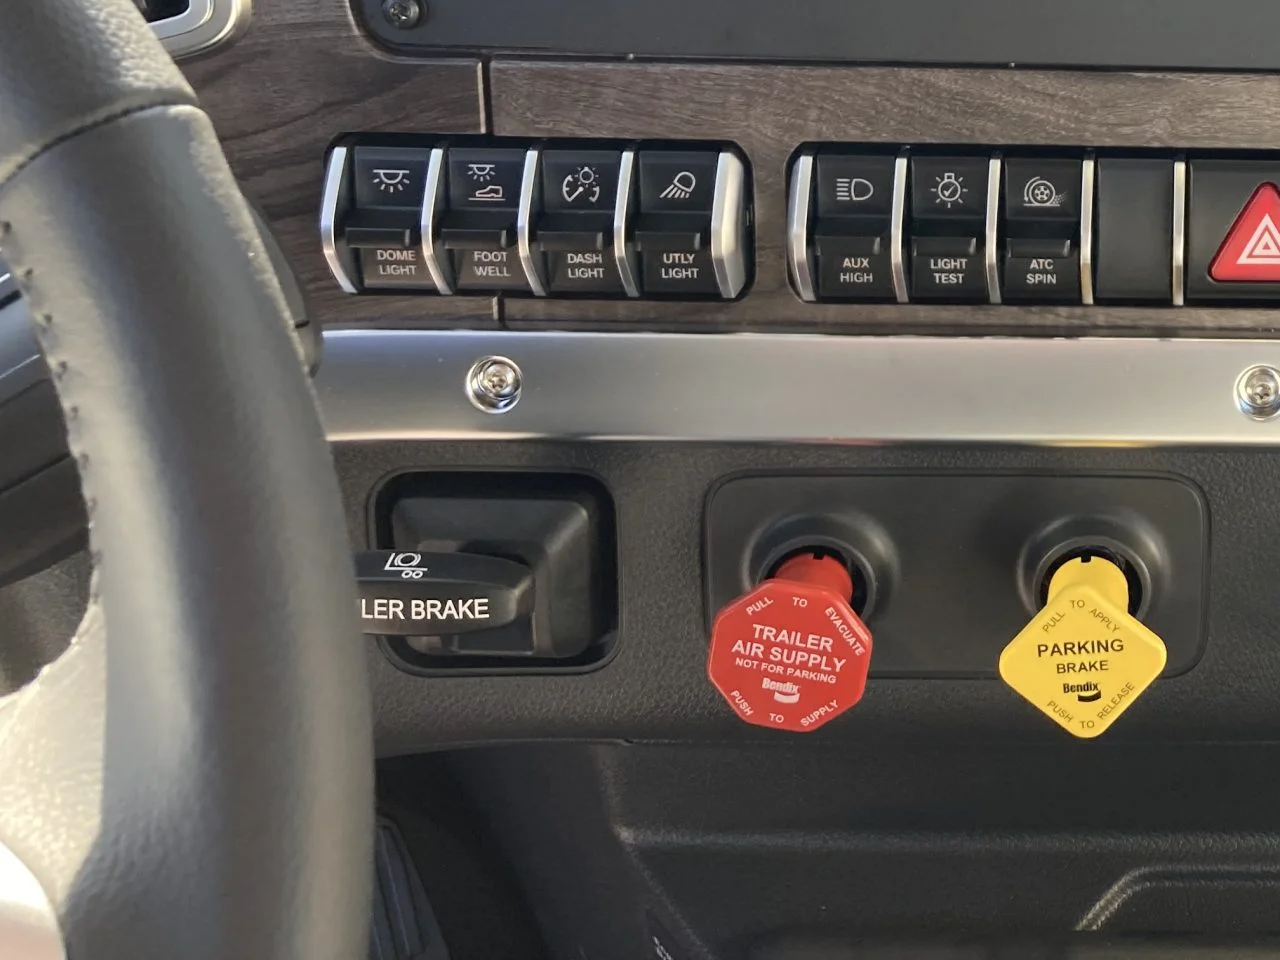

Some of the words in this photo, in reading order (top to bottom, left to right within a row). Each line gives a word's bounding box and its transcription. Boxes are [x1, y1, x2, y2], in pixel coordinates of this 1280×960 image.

[376, 250, 416, 262] DOME
[474, 251, 508, 263] FOOT
[567, 253, 602, 265] DASH
[663, 253, 695, 265] UTLY
[379, 264, 417, 276] LIGHT
[842, 258, 870, 269] AUX
[930, 258, 968, 270] LIGHT
[1030, 258, 1054, 271] ATC
[474, 266, 511, 277] WELL
[568, 267, 605, 279] LIGHT
[661, 267, 699, 280] LIGHT
[840, 271, 874, 283] HIGH
[933, 272, 964, 285] TEST
[1026, 273, 1057, 285] SPIN
[411, 598, 489, 620] BRAKE
[1042, 611, 1066, 634] PULL
[1070, 599, 1085, 609] TO
[1089, 607, 1121, 633] APPLY
[745, 596, 774, 616] PULL
[792, 597, 808, 608] TO
[824, 606, 865, 656] EVACUATE
[752, 623, 834, 652] TRAILER
[1037, 638, 1124, 658] PARKING
[731, 640, 764, 658] AIR
[769, 647, 847, 673] SUPPLY
[735, 657, 758, 669] NOT
[761, 663, 784, 674] FOR
[786, 667, 837, 684] PARKING
[1056, 660, 1109, 674] BRAKE
[762, 678, 800, 693] Bendix
[1063, 681, 1098, 694] Bendix
[730, 690, 754, 717] PUSH
[769, 712, 784, 723] TO
[800, 699, 838, 727] SUPPLY
[1047, 700, 1074, 724] PUSH
[1080, 720, 1095, 729] TO
[1097, 681, 1136, 720] RELEASE
